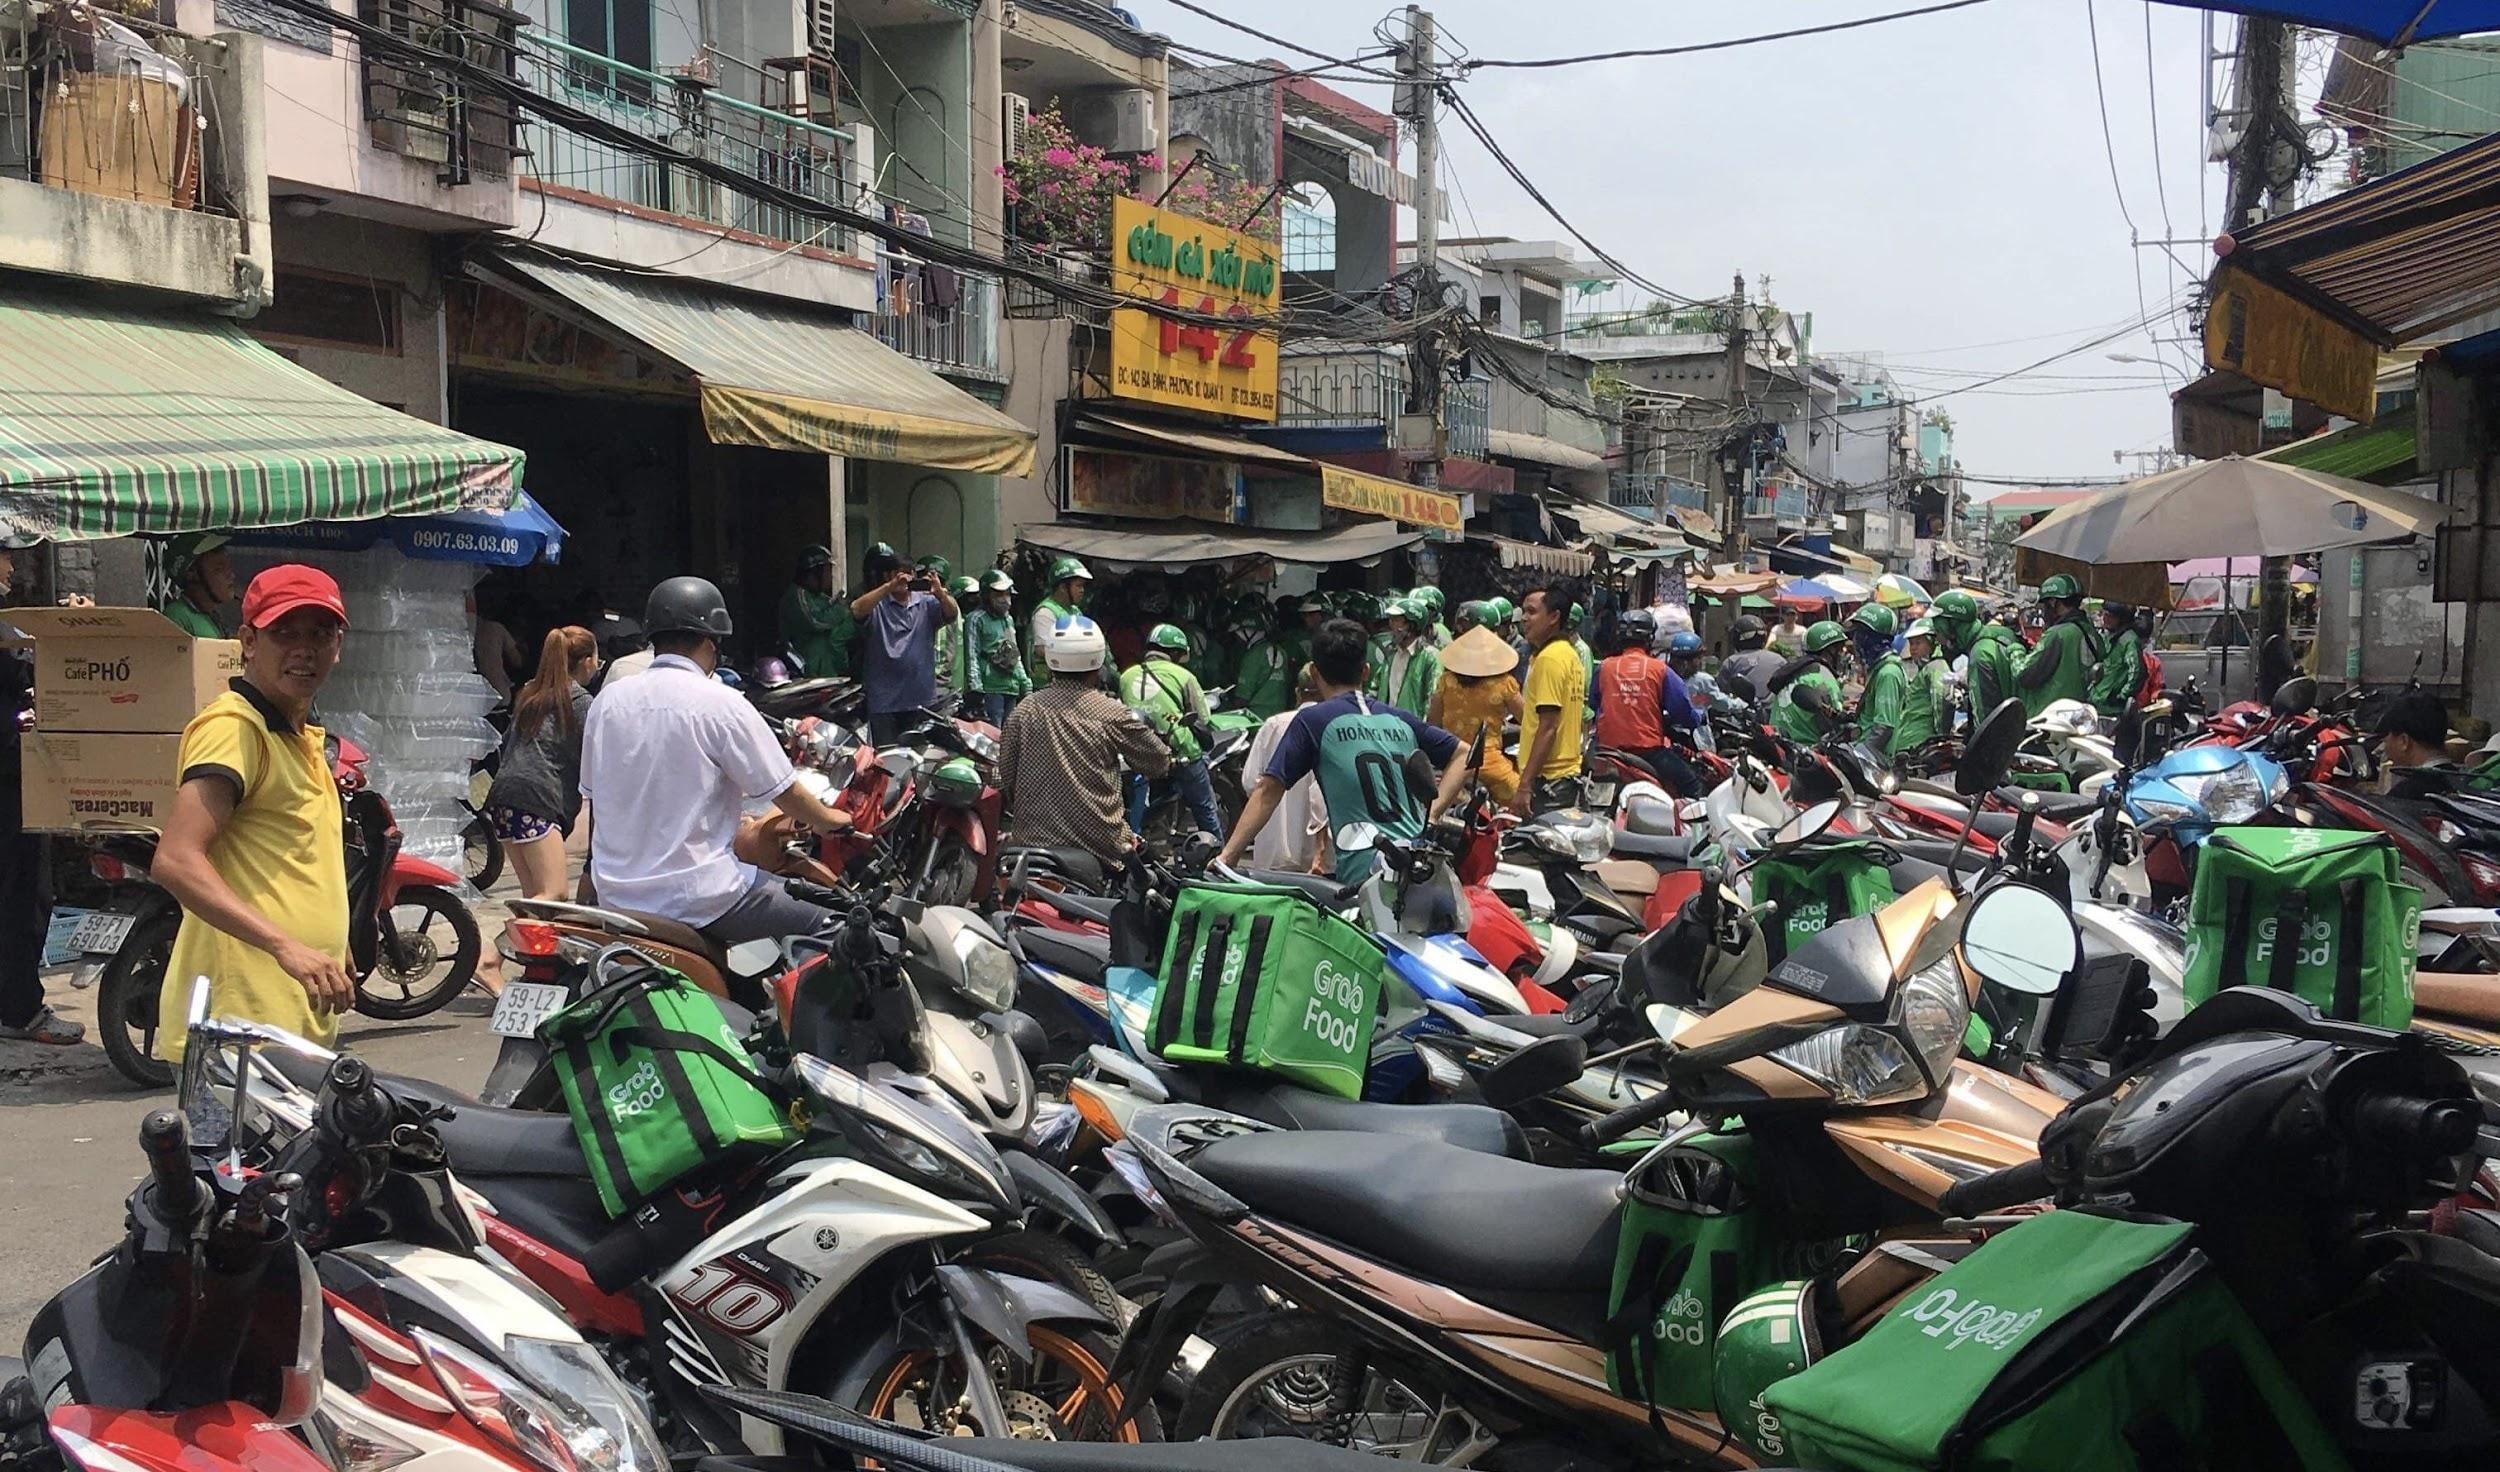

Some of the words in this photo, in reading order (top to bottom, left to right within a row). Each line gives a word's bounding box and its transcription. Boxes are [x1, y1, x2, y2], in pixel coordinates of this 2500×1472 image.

[1155, 286, 1256, 369] 142
[413, 530, 519, 555] 0907.63.03.09
[1860, 610, 1878, 623] Grab
[1948, 604, 1967, 614] Grab
[1820, 631, 1839, 641] Grab
[65, 666, 87, 681] Café
[88, 656, 130, 681] PHỐ
[230, 657, 244, 671] PH
[1620, 682, 1641, 693] Now
[1383, 728, 1408, 742] NAM
[2256, 941, 2330, 967] Fod
[1189, 964, 1239, 985] Fd
[1314, 959, 1364, 1015] Grab
[508, 987, 557, 1011] 59-L2
[1303, 996, 1359, 1054] Food
[608, 1060, 657, 1104] Grab
[612, 1075, 666, 1124] Food
[676, 1262, 782, 1330] 10
[1900, 1288, 2043, 1350] GrabFo
[1652, 1318, 1704, 1346] ood
